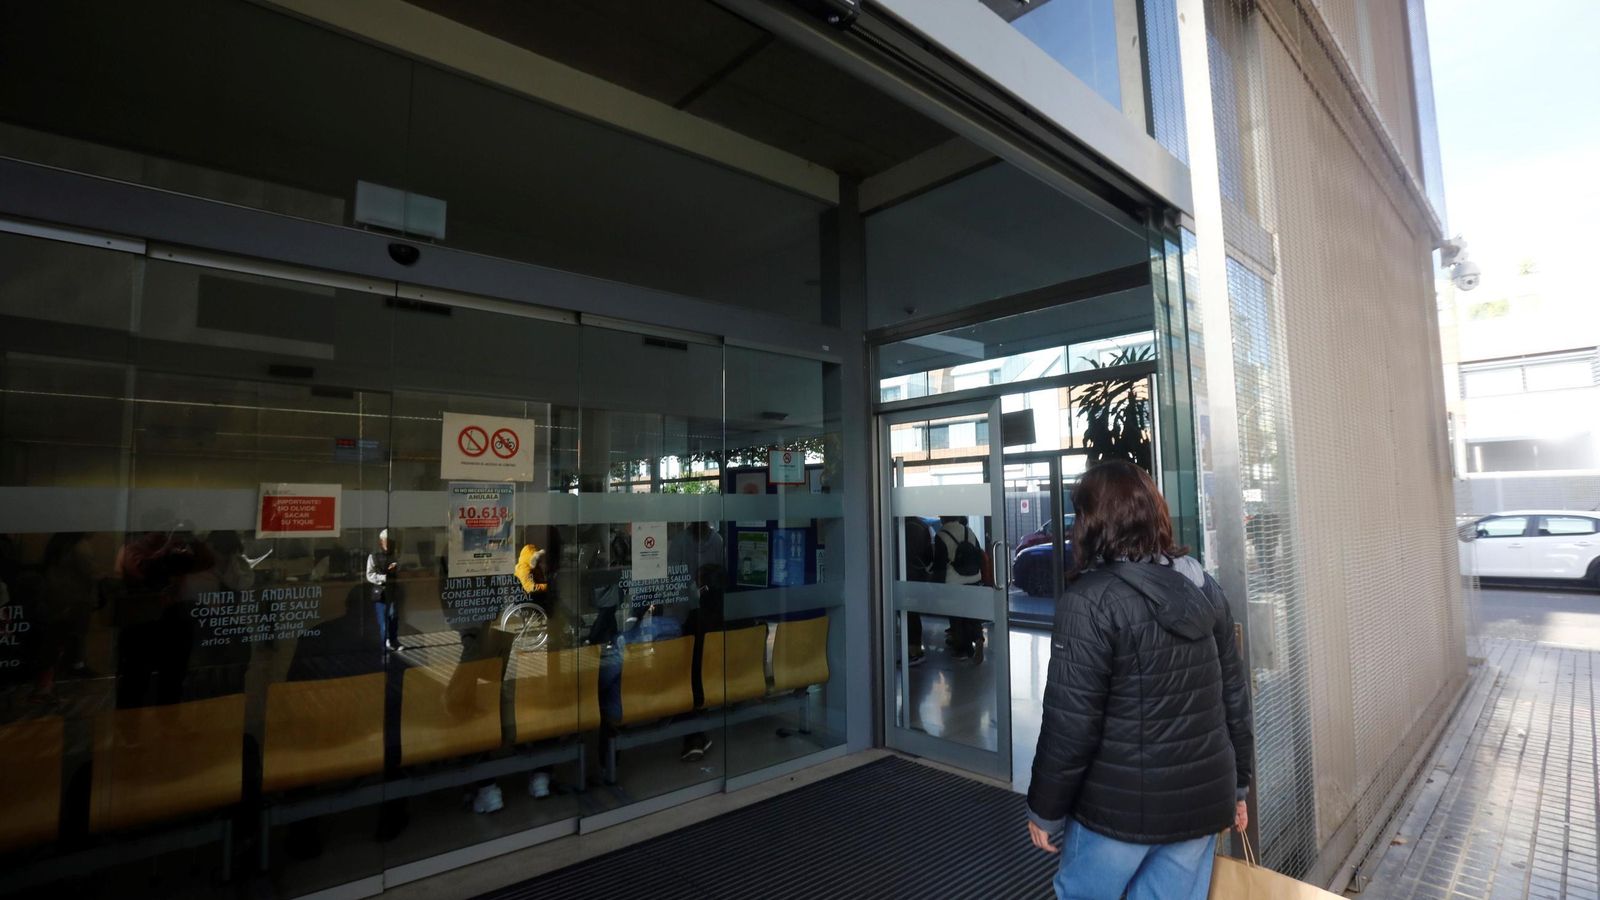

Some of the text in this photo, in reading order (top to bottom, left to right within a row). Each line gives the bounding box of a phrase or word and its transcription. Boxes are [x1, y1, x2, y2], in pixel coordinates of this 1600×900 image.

[459, 507, 508, 519] 10.618
[668, 564, 689, 575] ALUCIA
[444, 578, 472, 590] JUNTA
[476, 576, 487, 587] DE
[670, 574, 691, 582] SALUD
[497, 586, 509, 595] DE
[629, 585, 666, 595] BIENESTAR
[666, 583, 688, 591] SOCIAL
[195, 591, 235, 606] JUNTA
[240, 589, 256, 603] DE
[447, 601, 454, 609] Y
[455, 596, 501, 608] BIENESTAR
[504, 593, 534, 604] SOCIAL
[631, 593, 653, 601] Centro
[190, 600, 319, 618] CONSEJERÍ DE SALU
[458, 606, 487, 615] Centro
[488, 605, 499, 613] de
[198, 610, 320, 628] Y BIENESTAR SOCIAL
[472, 612, 497, 622] Castill
[213, 621, 304, 636] Centro de Salud
[200, 629, 321, 647] arlos astilla del Pino
